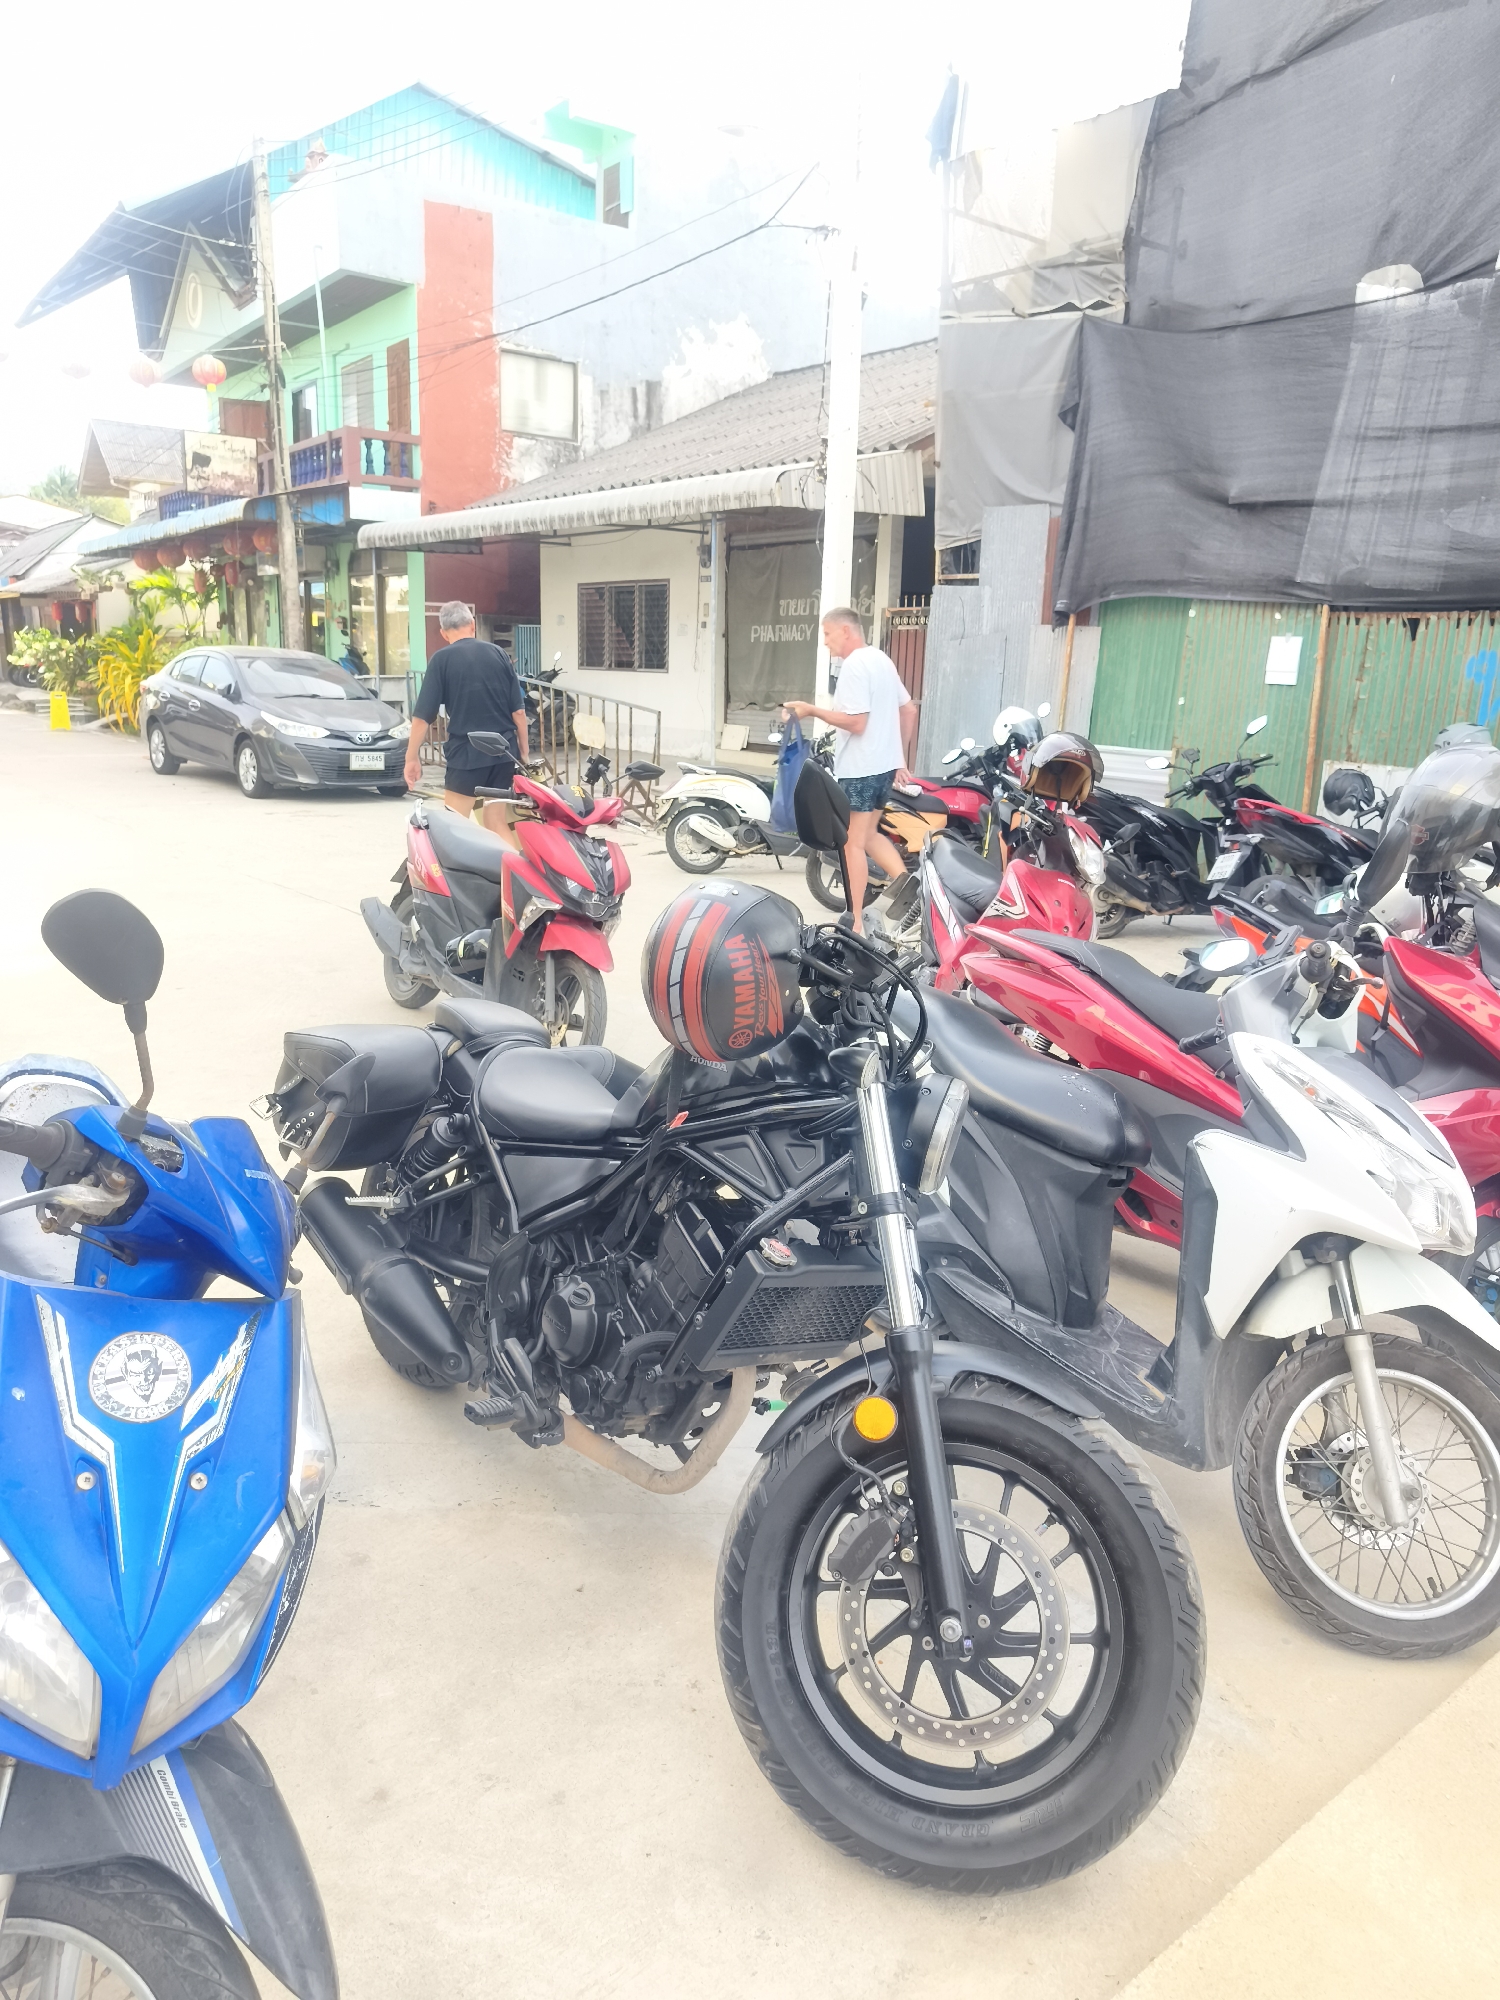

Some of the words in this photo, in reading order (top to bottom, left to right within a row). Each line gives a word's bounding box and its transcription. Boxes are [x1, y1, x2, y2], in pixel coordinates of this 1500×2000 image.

[751, 624, 815, 642] PHARMACY
[749, 938, 763, 973] Heart
[724, 933, 756, 1030] YAMAHA
[759, 974, 768, 1000] Your
[754, 1003, 766, 1038] Revs
[690, 1055, 728, 1073] HONDA
[134, 1333, 189, 1381] INFERNO
[156, 1769, 176, 1799] Combi
[170, 1801, 187, 1828] Brake
[845, 1780, 904, 1822] HIGH
[911, 1815, 990, 1838] GRAND
